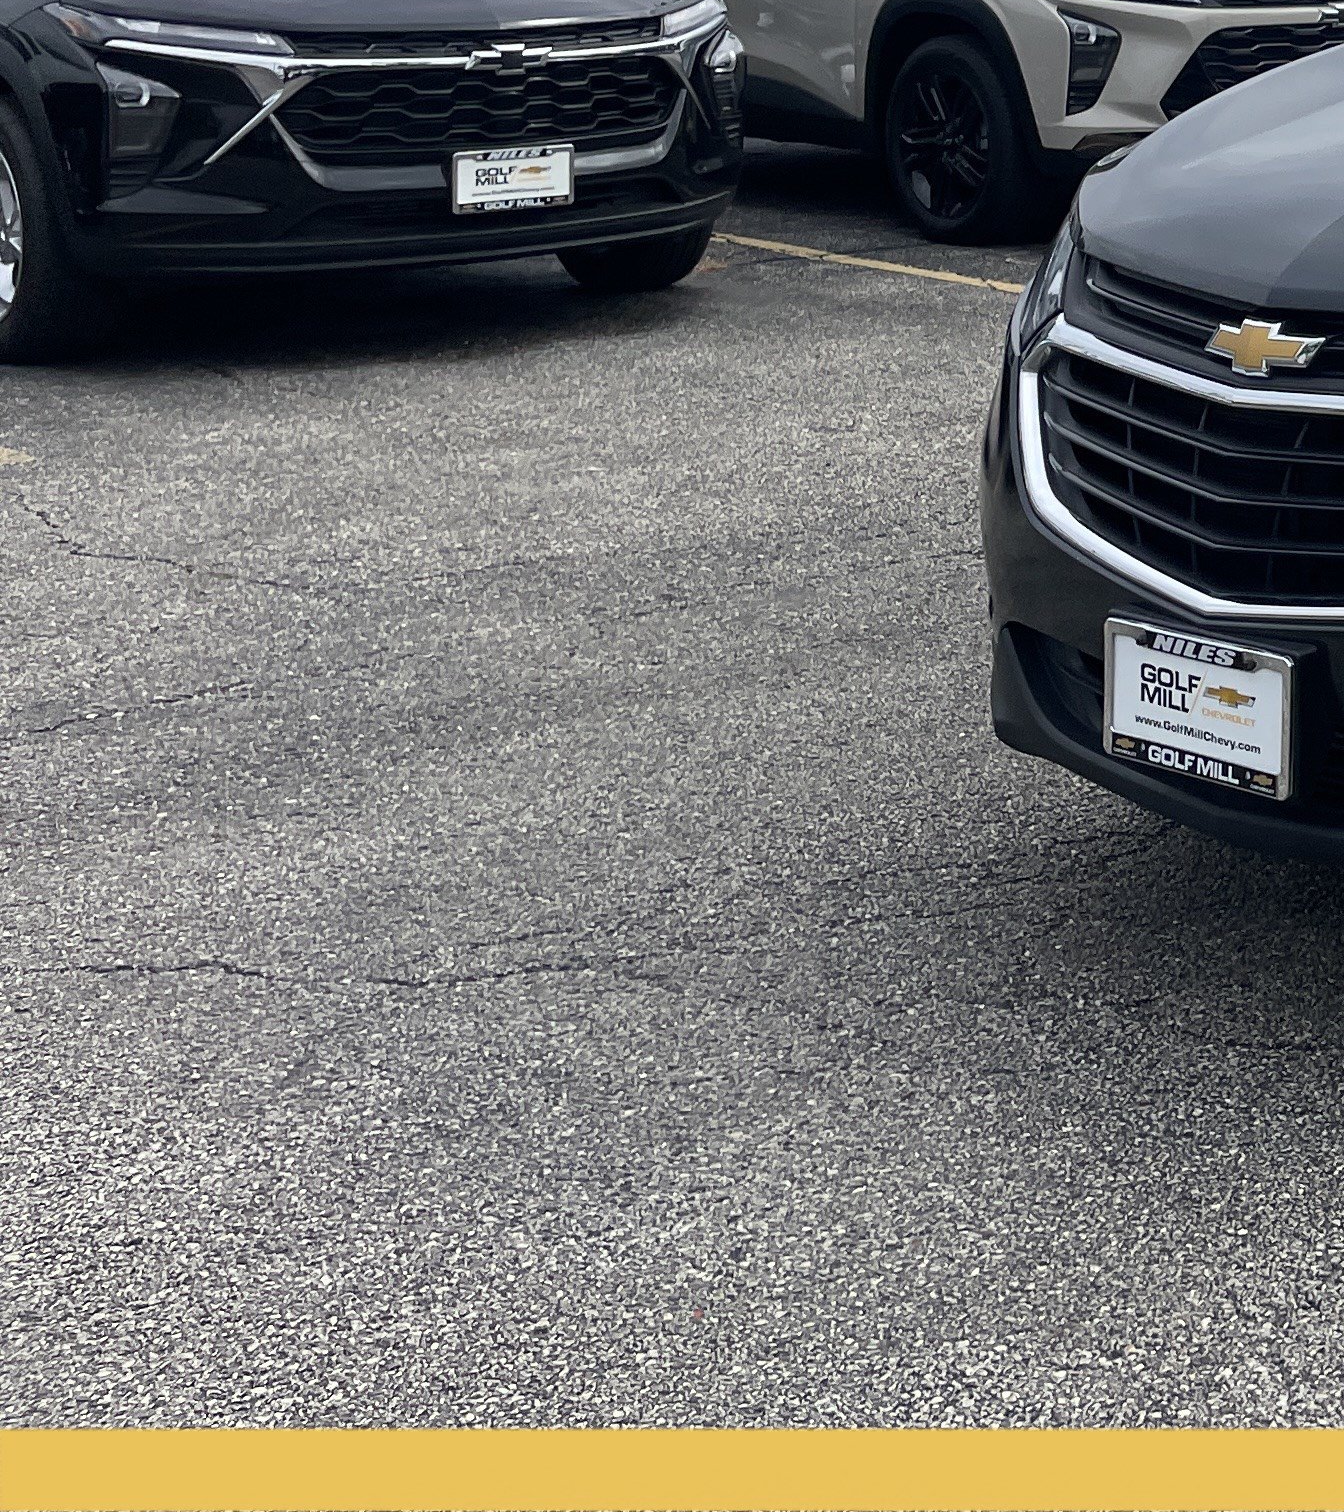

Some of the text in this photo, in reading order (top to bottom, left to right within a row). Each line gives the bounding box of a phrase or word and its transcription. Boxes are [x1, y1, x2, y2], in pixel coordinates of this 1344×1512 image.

[475, 165, 518, 178] GOLF
[475, 175, 509, 187] MILL
[1152, 634, 1237, 667] NILES
[1140, 663, 1202, 694] GOLF
[1140, 682, 1190, 713] MILL
[1201, 707, 1256, 728] CHEVROLET
[1134, 714, 1262, 755] www.GolfMillChevy.com
[1147, 743, 1240, 785] GOLF MILL
